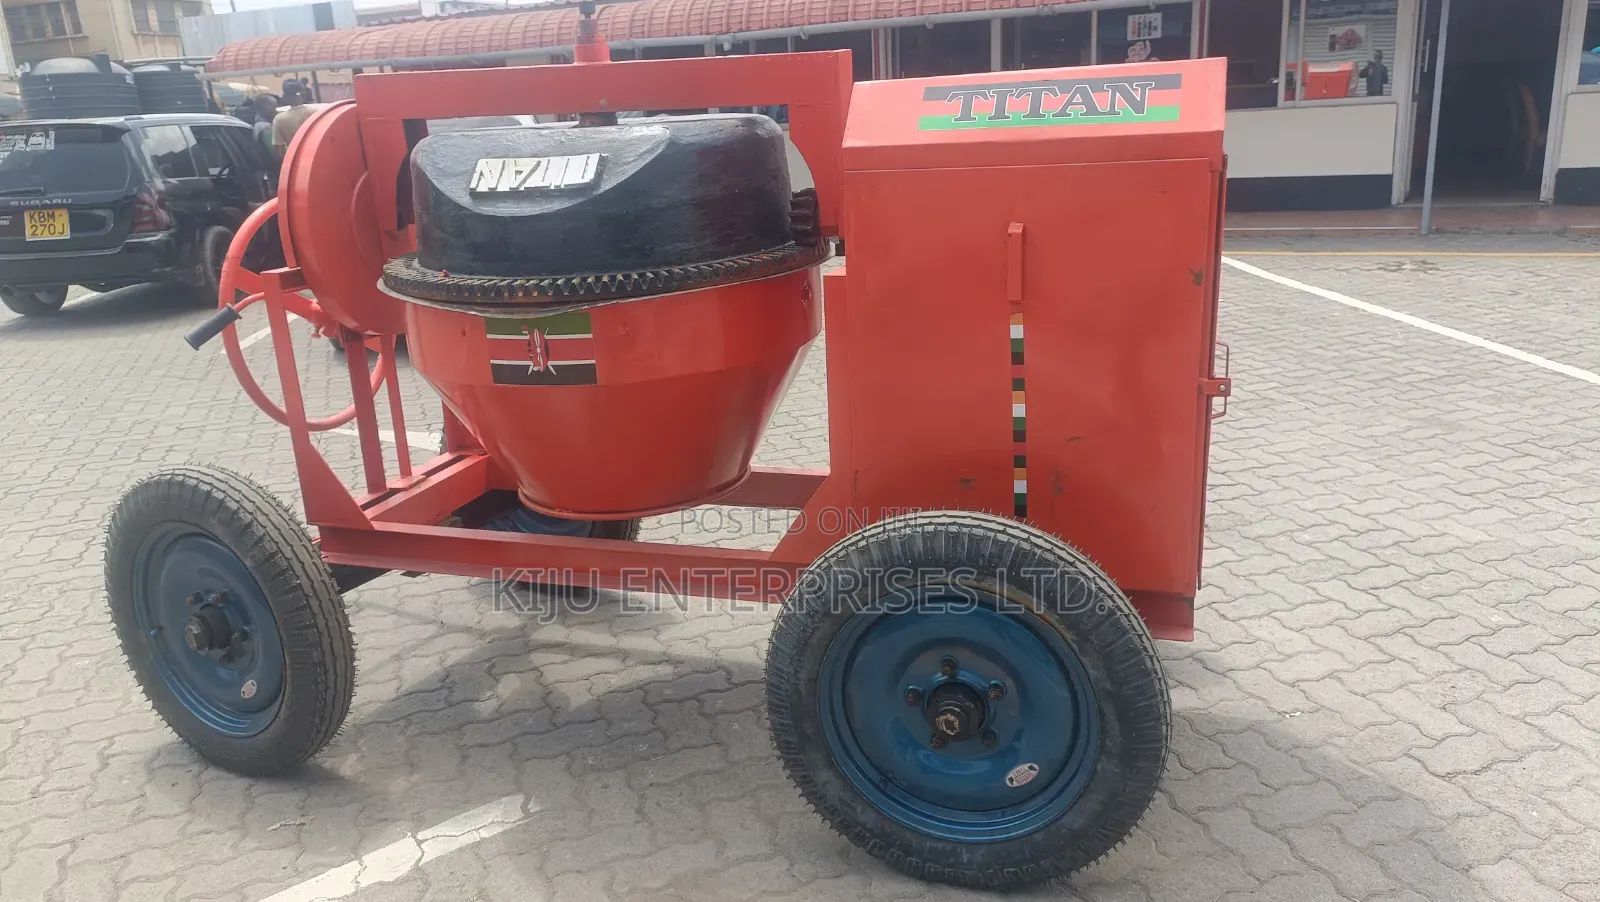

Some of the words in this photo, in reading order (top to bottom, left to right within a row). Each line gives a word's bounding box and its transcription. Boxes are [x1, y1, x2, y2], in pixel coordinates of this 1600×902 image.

[946, 82, 1155, 122] TITAN
[469, 153, 600, 192] TITAN
[10, 198, 73, 206] SUBARU
[29, 210, 56, 224] KBM
[30, 223, 65, 236] 270J
